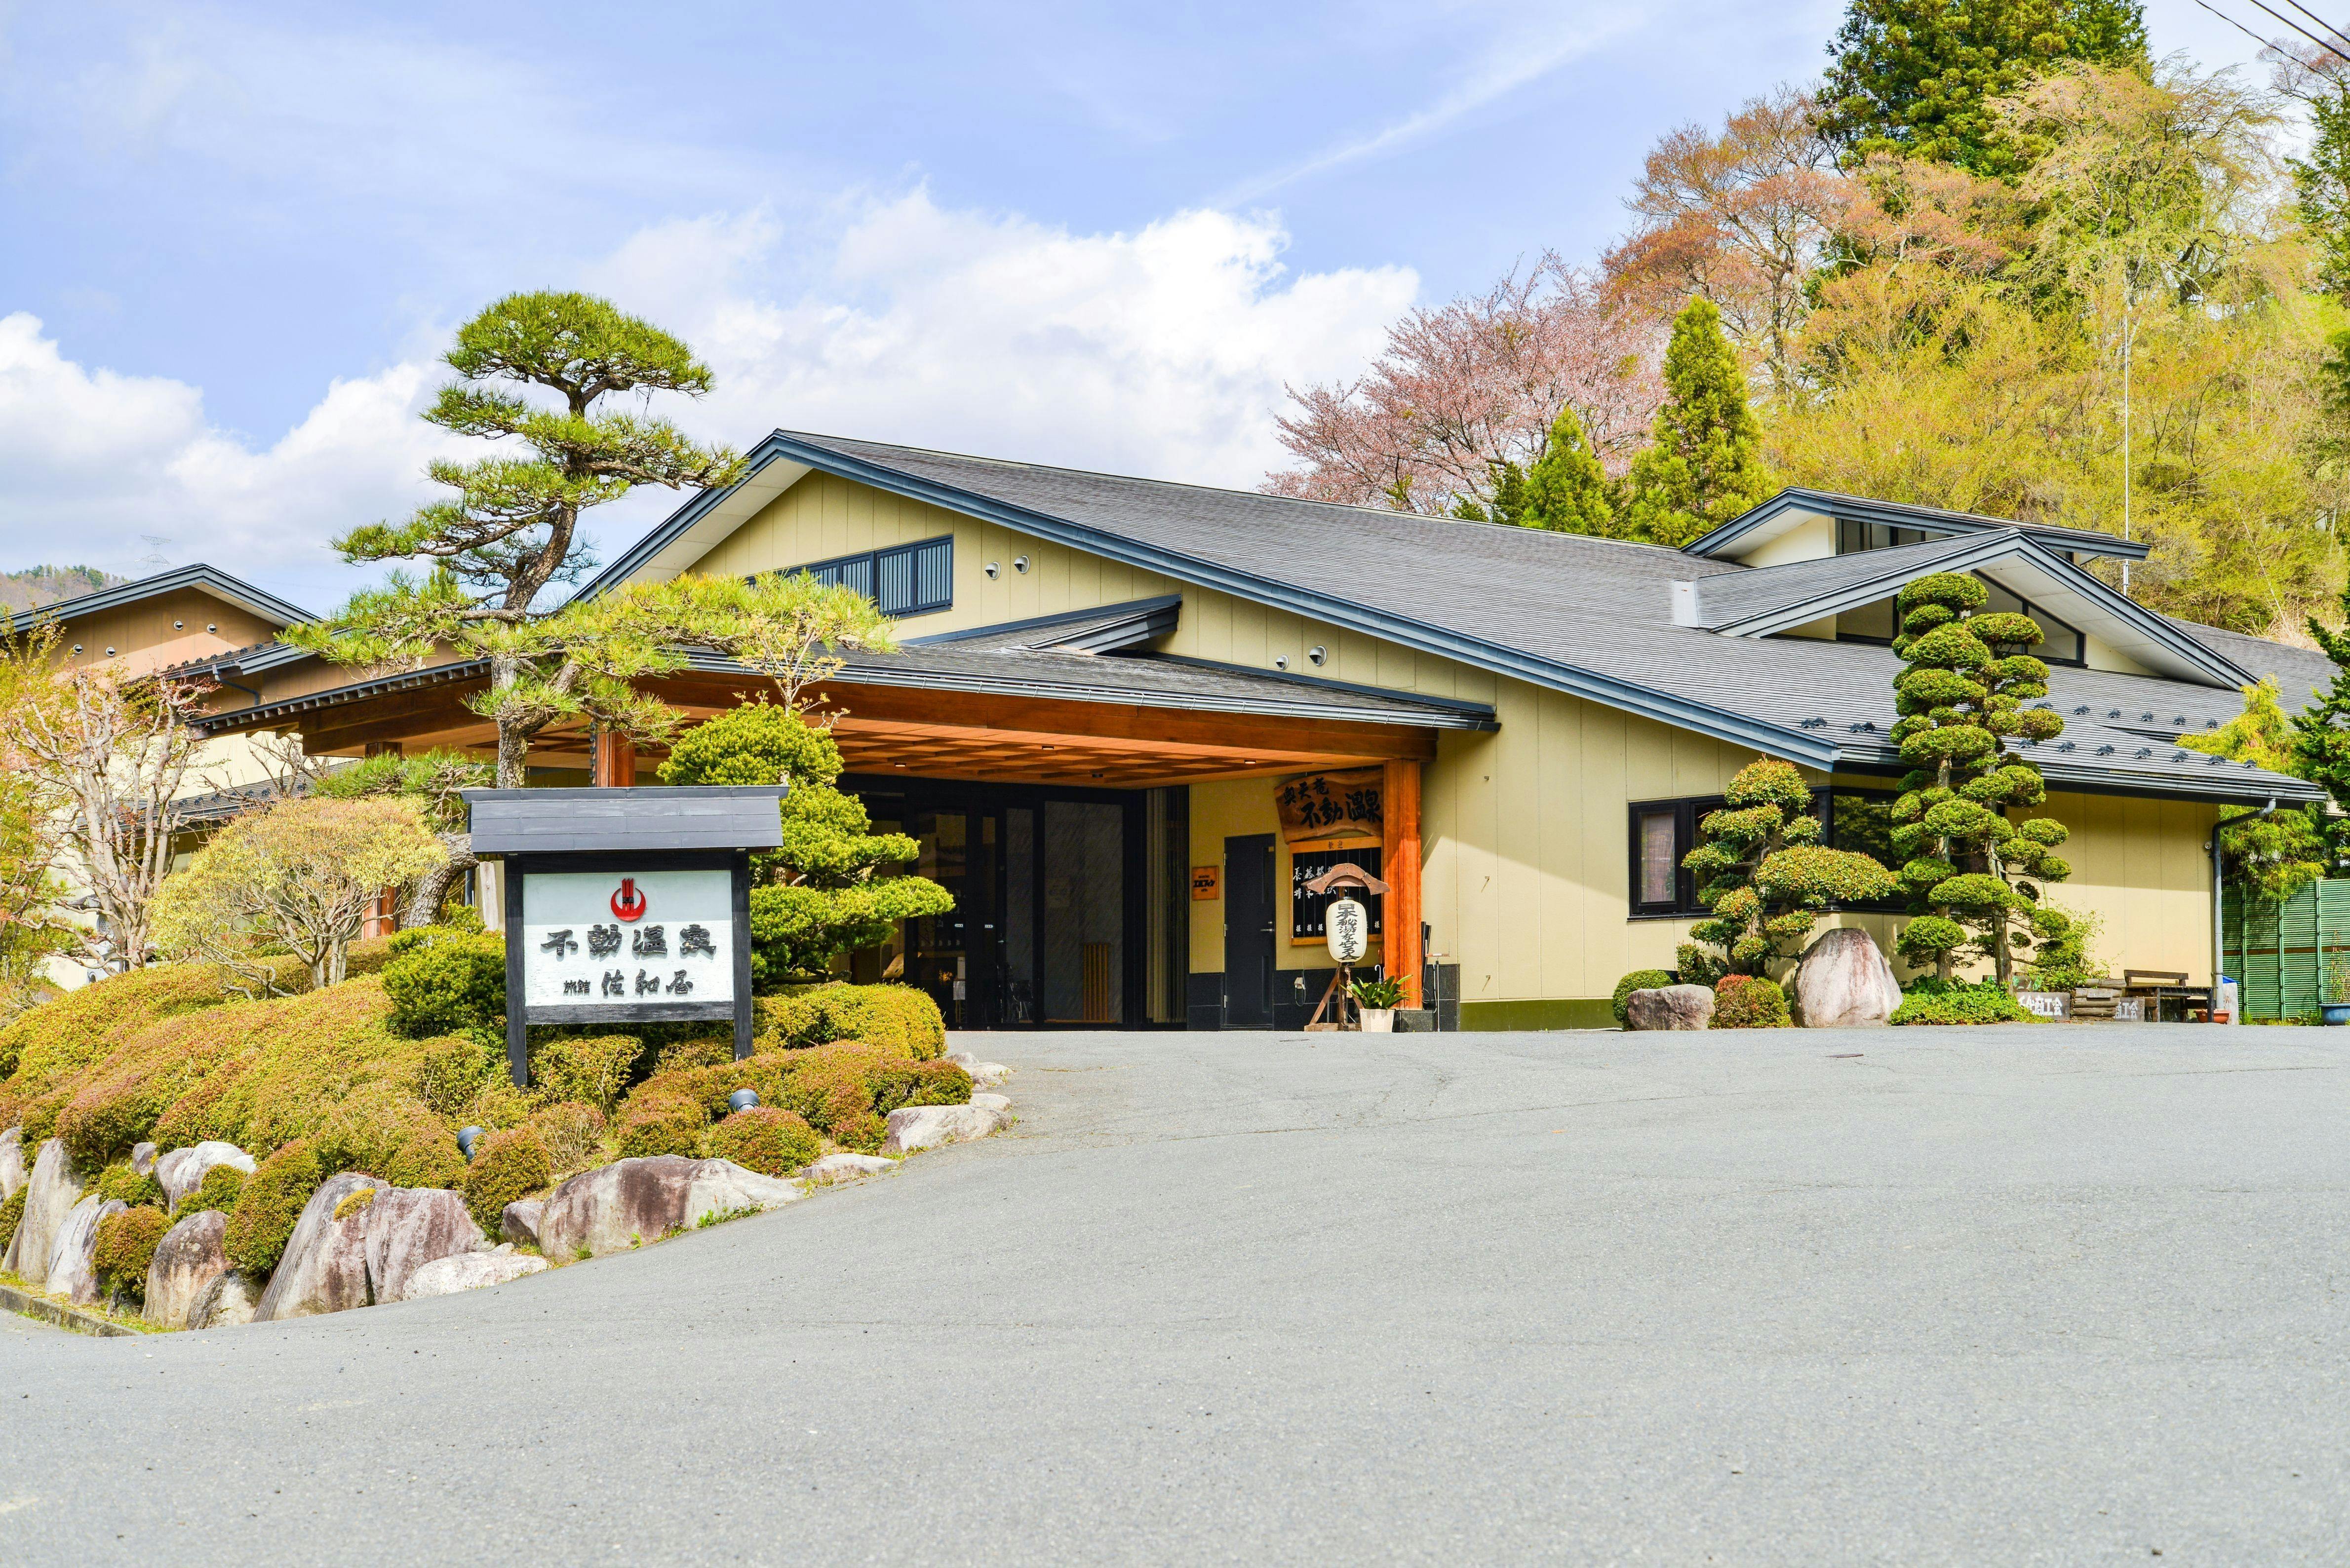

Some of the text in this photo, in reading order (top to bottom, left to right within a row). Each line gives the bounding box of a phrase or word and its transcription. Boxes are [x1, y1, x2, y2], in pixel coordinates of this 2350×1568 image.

[1300, 789, 1383, 829] 不動温泉
[541, 924, 717, 956] 不動温泉
[1335, 904, 1360, 960] 日本秘湯を守る会
